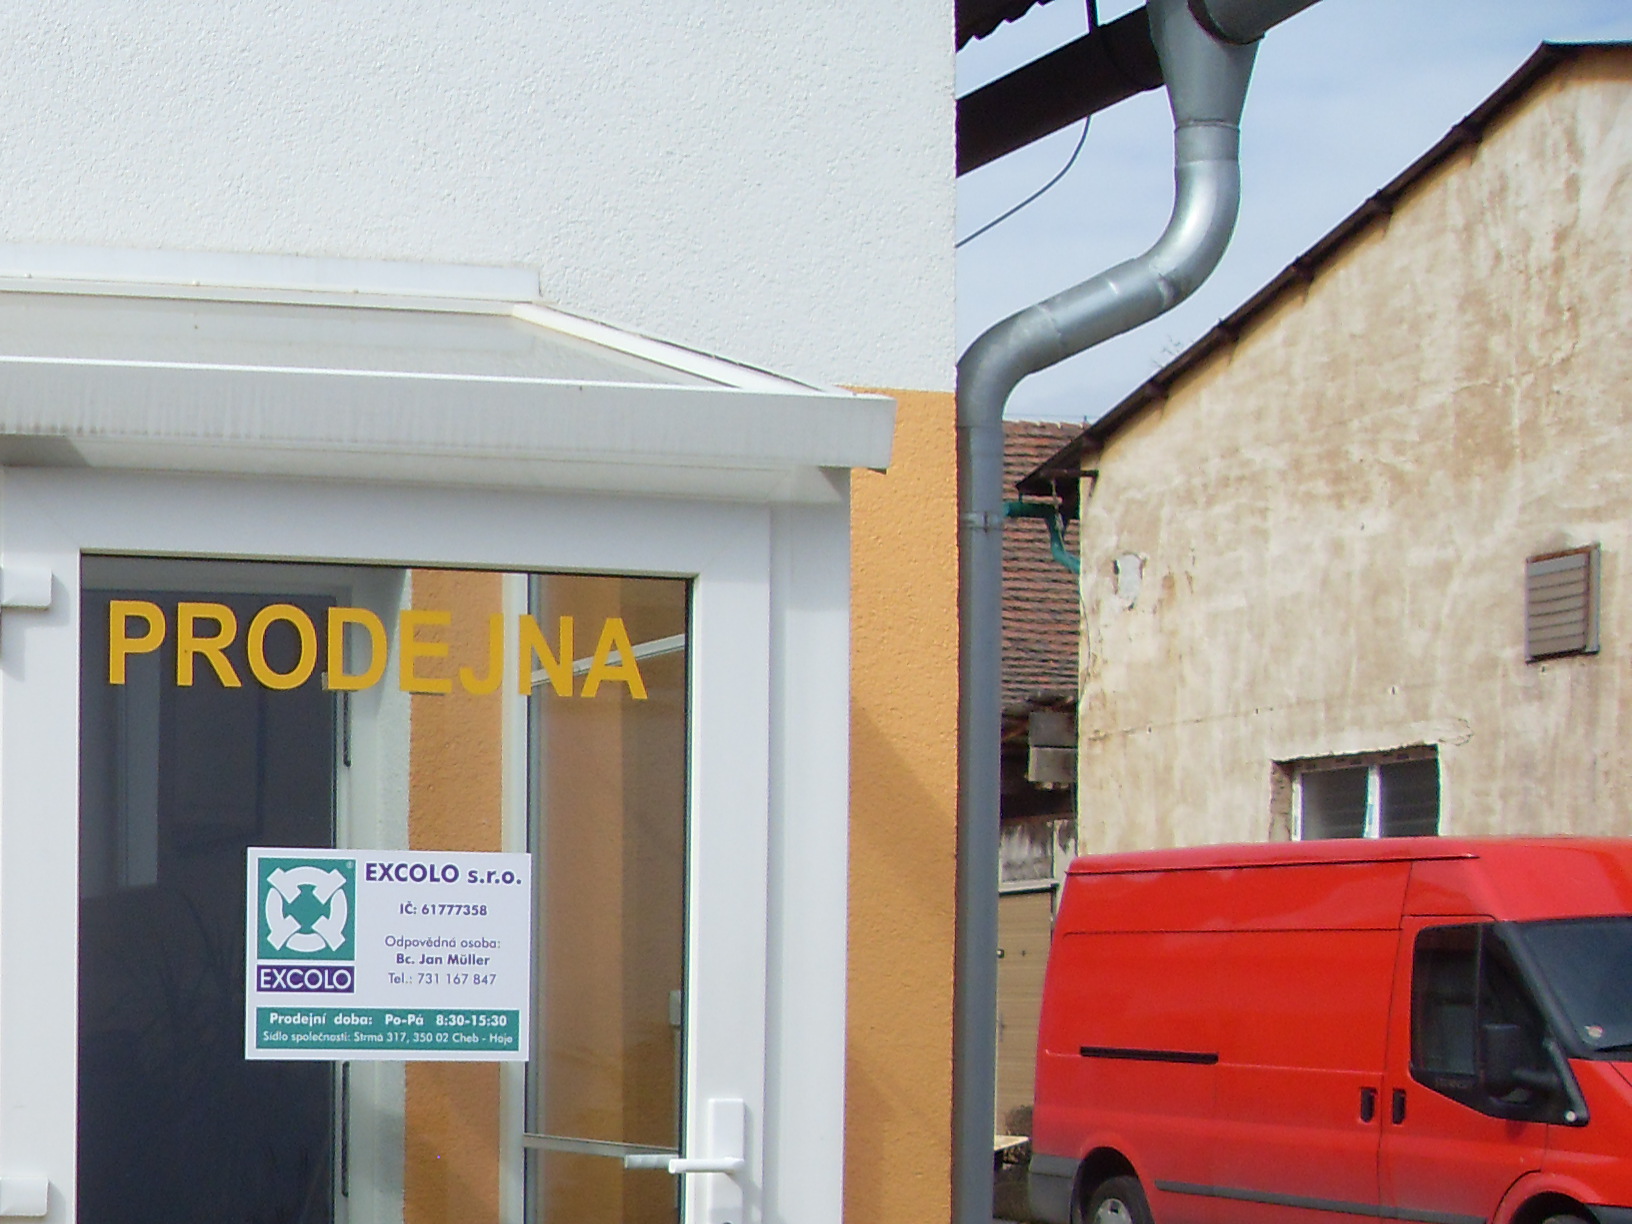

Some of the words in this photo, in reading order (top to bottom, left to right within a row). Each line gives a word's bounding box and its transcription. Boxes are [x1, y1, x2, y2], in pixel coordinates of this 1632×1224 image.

[108, 599, 649, 700] PRODEJNA
[365, 862, 460, 883] EXCOLO
[467, 869, 522, 885] s.r.o.
[399, 901, 417, 915] IČ:
[421, 903, 488, 916] 61777358
[384, 935, 457, 949] Odpovědná
[460, 937, 501, 949] osoba:
[396, 953, 415, 965] Bc.
[418, 954, 443, 965] Jan
[447, 954, 491, 966] Müller
[260, 968, 352, 990] EXCOLO
[388, 972, 413, 985] Tel.:
[418, 973, 439, 985] 731
[446, 973, 468, 985] 167
[473, 974, 497, 985] 847
[269, 1012, 326, 1027] Prodejní
[333, 1012, 373, 1025] doba:
[385, 1014, 424, 1026] Po-Pá
[436, 1014, 507, 1026] 8:30-15:30
[263, 1030, 289, 1041] Sídlo
[291, 1031, 350, 1043] společnosti:
[387, 1032, 409, 1043] 317,
[413, 1032, 433, 1043] 350
[435, 1033, 449, 1043] 02
[452, 1033, 479, 1044] Cheb
